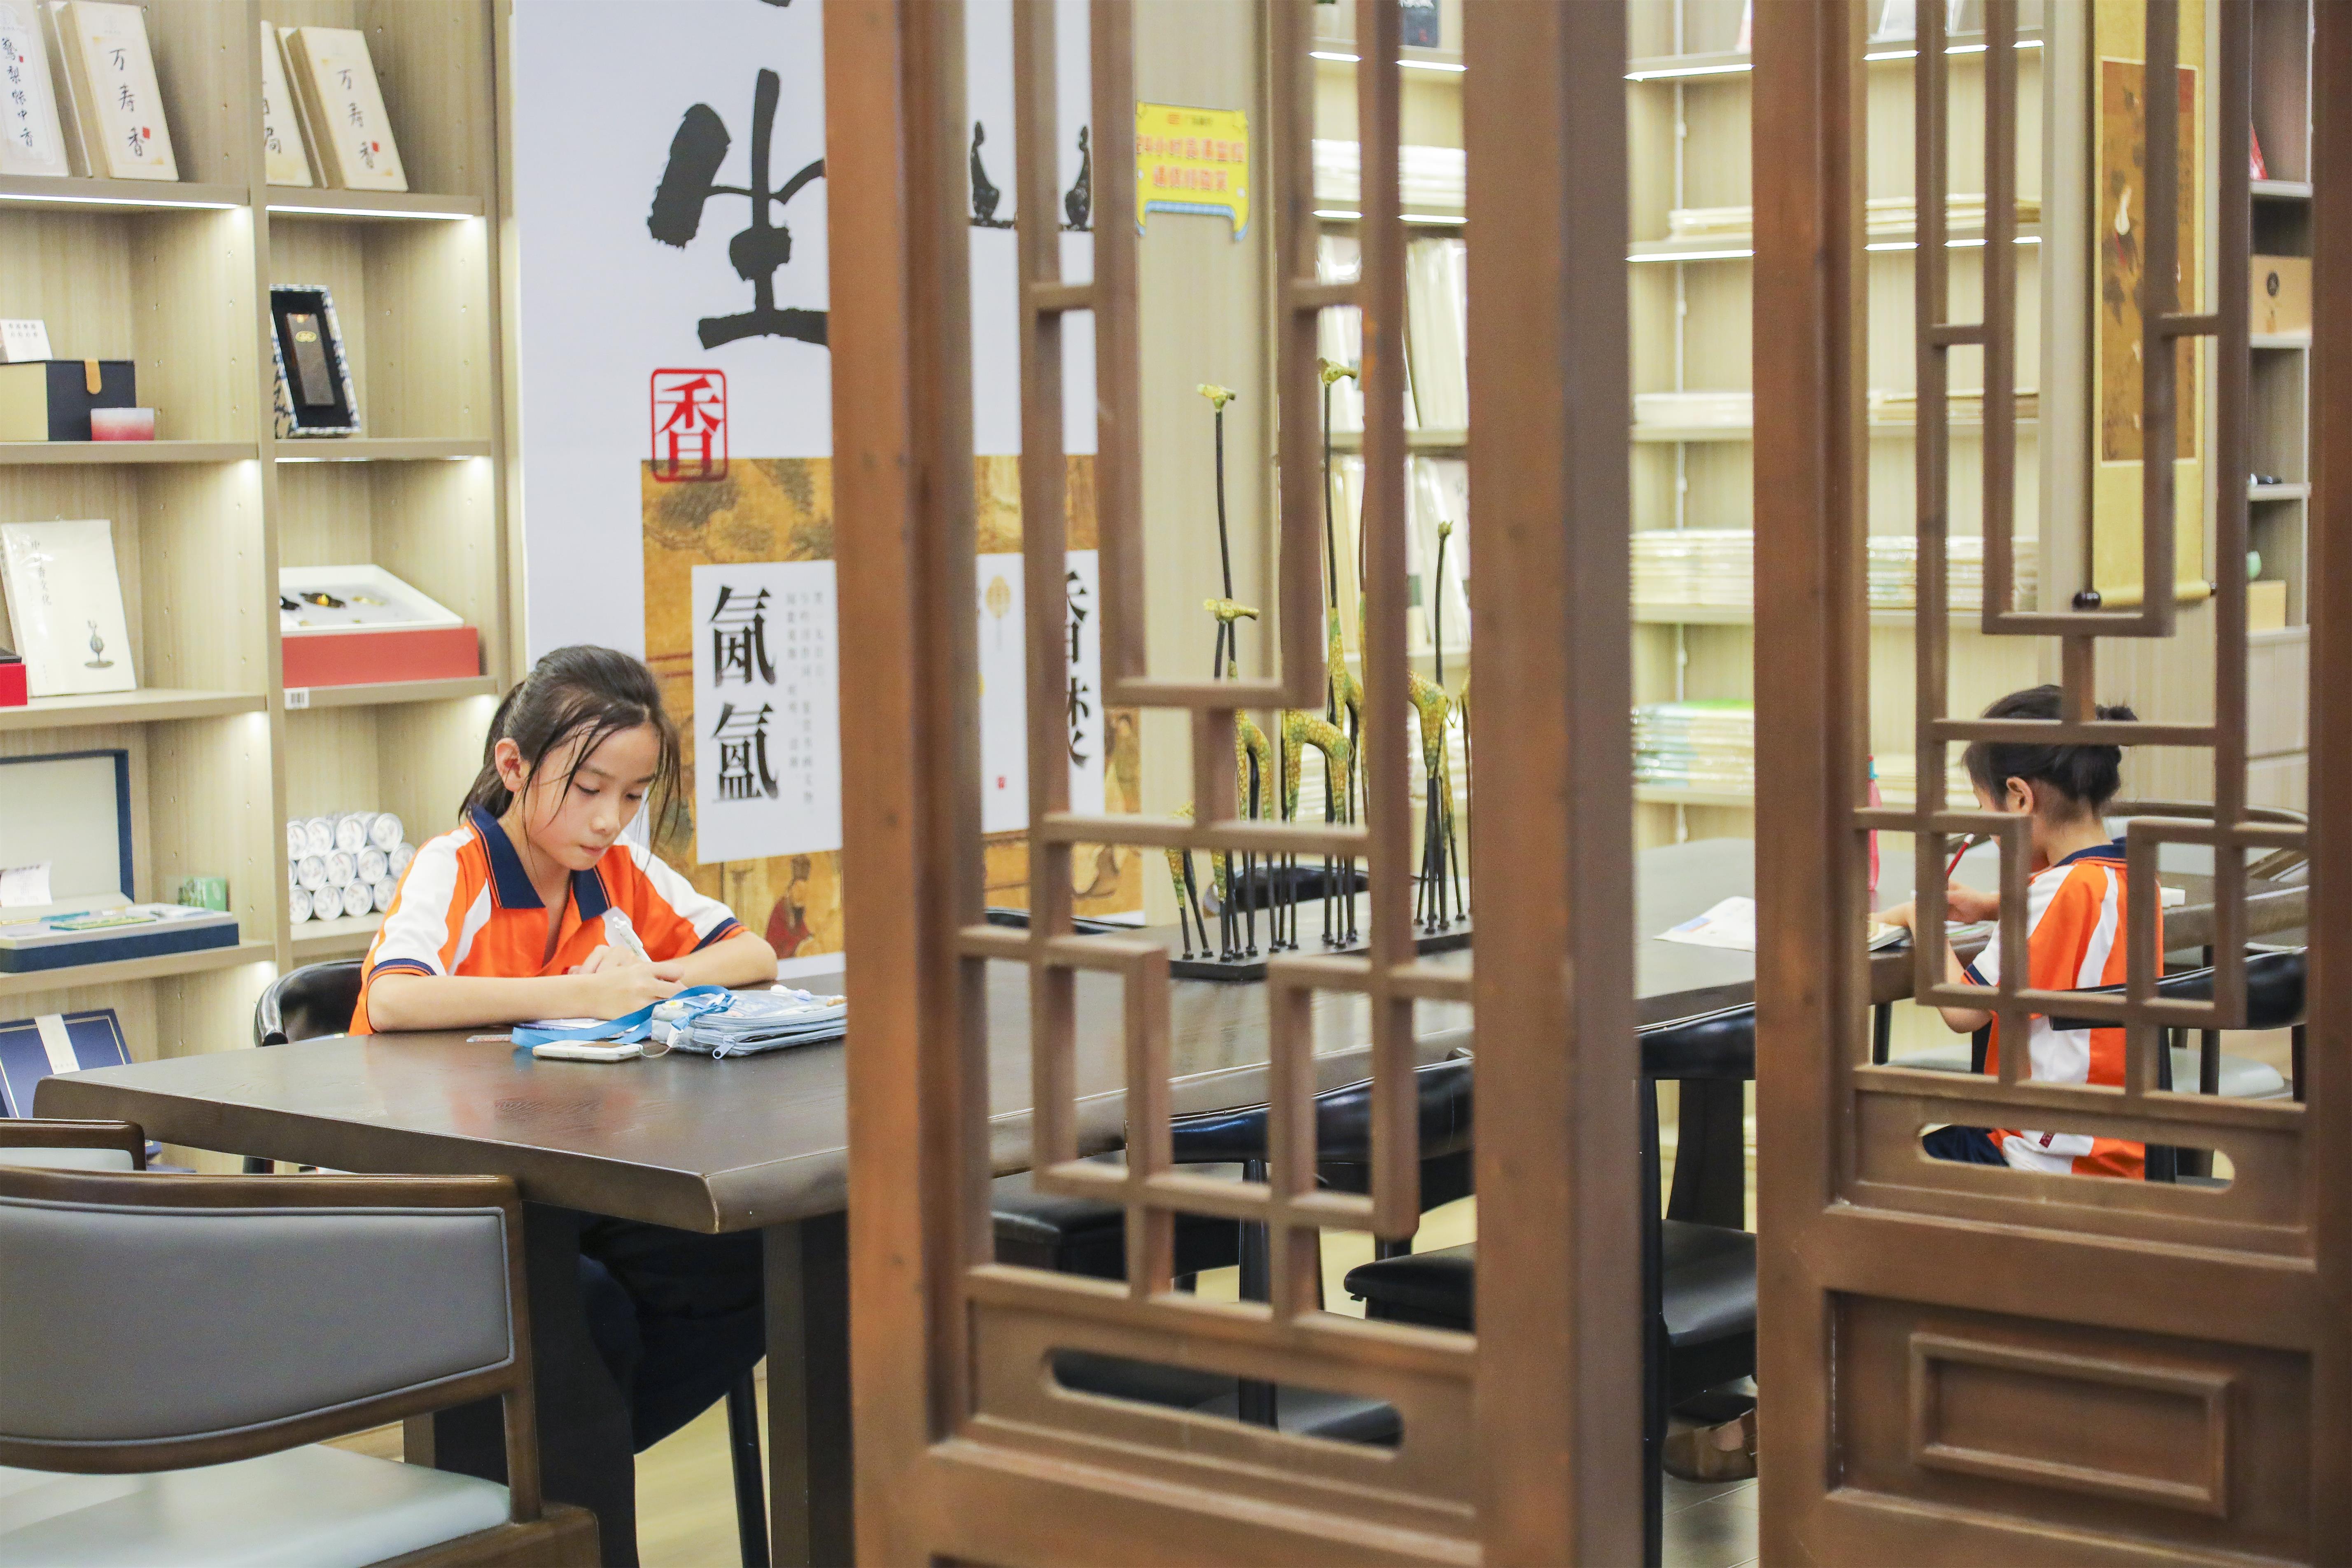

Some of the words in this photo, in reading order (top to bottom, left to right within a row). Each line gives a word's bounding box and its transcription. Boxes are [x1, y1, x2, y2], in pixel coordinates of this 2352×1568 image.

[109, 48, 144, 156] 万寿香
[337, 68, 375, 169] 万寿香
[657, 375, 723, 478] 香
